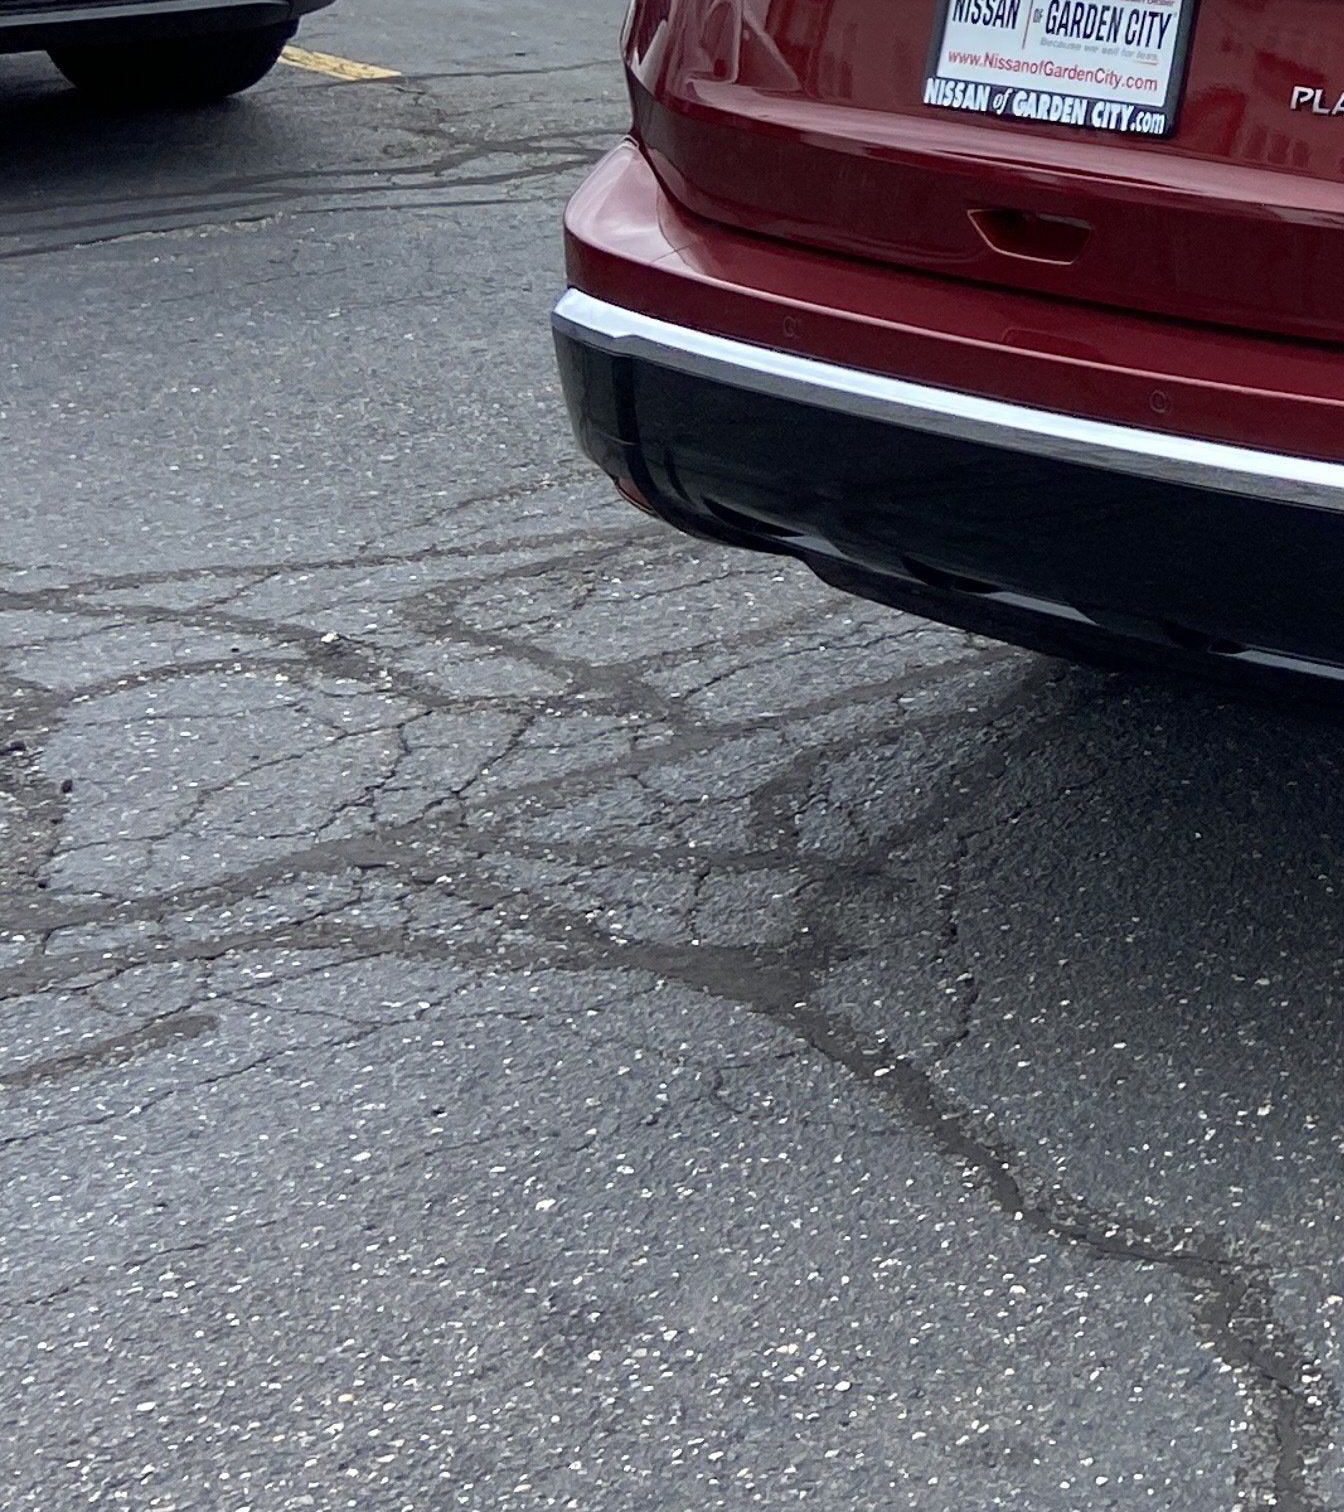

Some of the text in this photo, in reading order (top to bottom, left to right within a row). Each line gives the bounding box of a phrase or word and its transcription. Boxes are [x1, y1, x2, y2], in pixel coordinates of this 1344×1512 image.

[1125, 8, 1172, 49] CITY
[948, 50, 1158, 92] www.NissanofGardenCity.com
[923, 77, 1165, 135] NISSAN of GARDEN CITY.com
